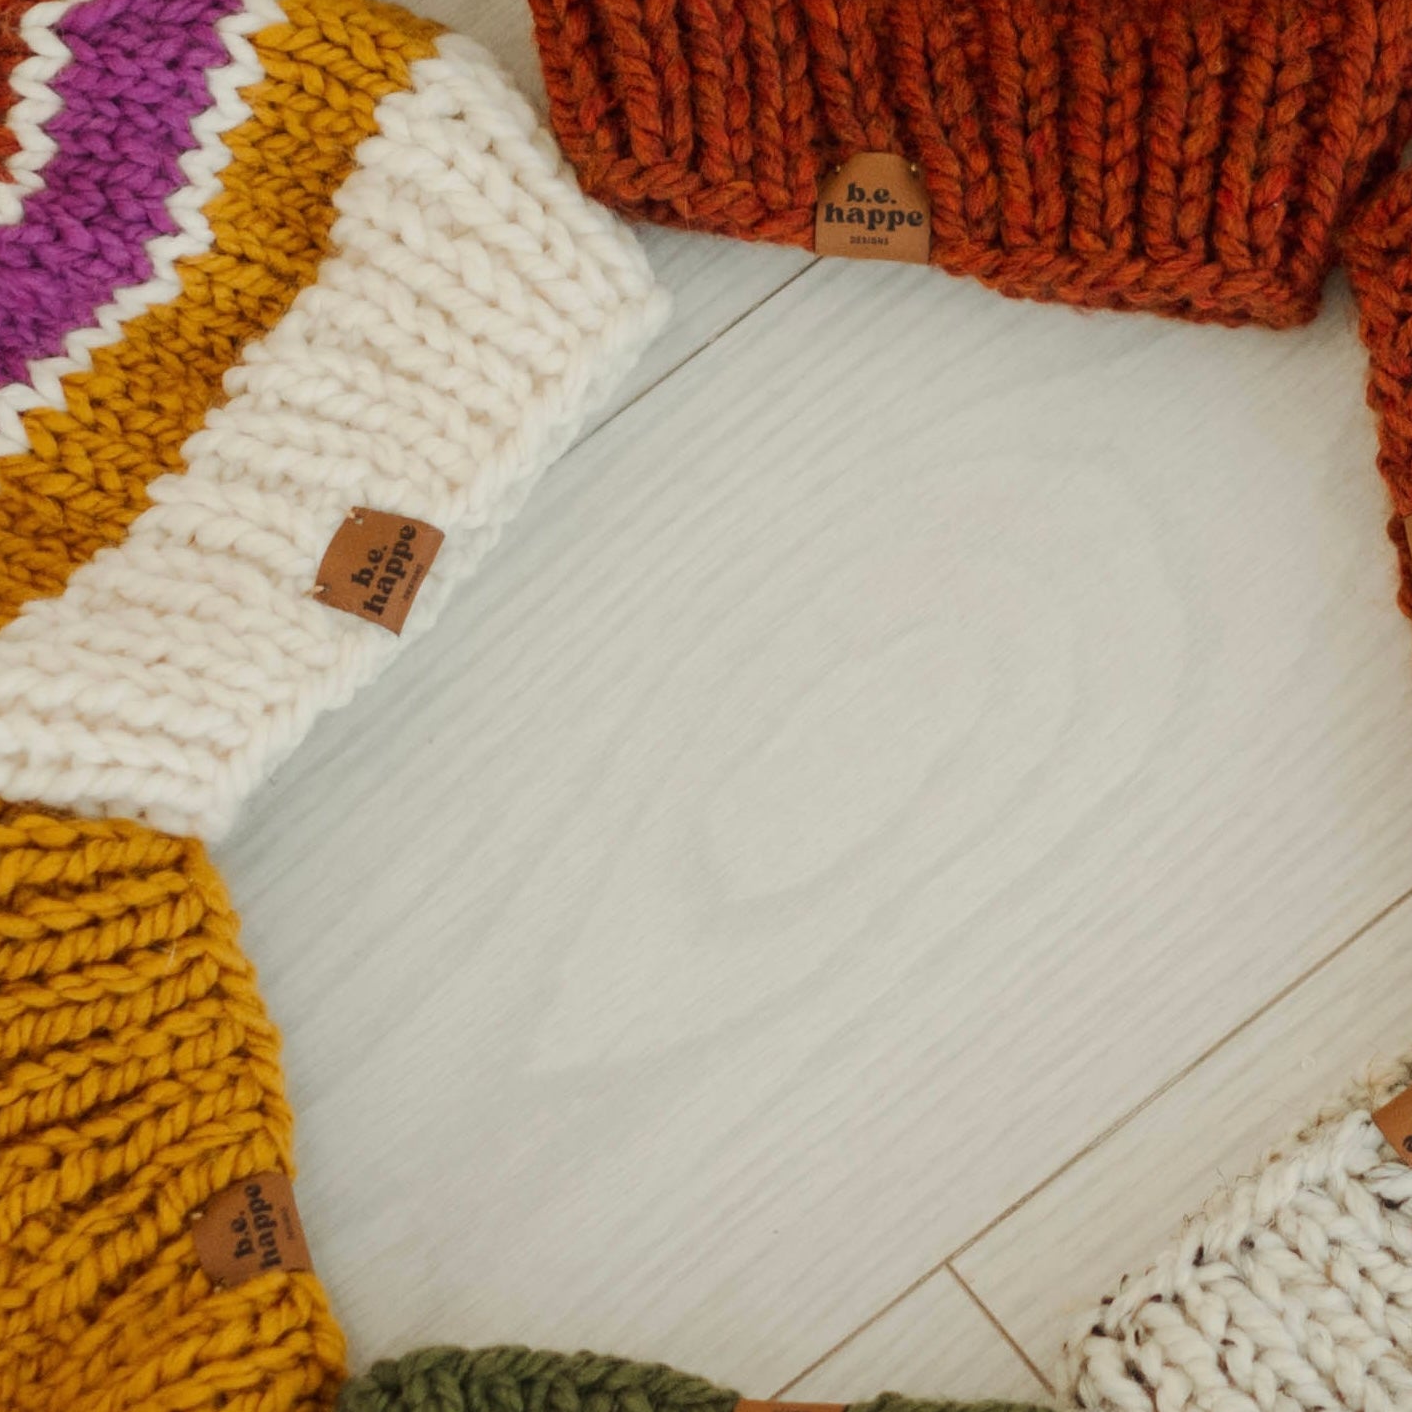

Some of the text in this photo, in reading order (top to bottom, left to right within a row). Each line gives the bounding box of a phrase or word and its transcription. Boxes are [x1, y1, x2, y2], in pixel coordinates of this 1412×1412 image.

[846, 182, 896, 204] b.e.
[825, 203, 924, 231] happe
[850, 236, 889, 246] DESIGNS
[350, 544, 388, 586] b.e.
[363, 524, 418, 616] happe
[231, 1209, 254, 1258] b.e.
[244, 1184, 283, 1271] happe
